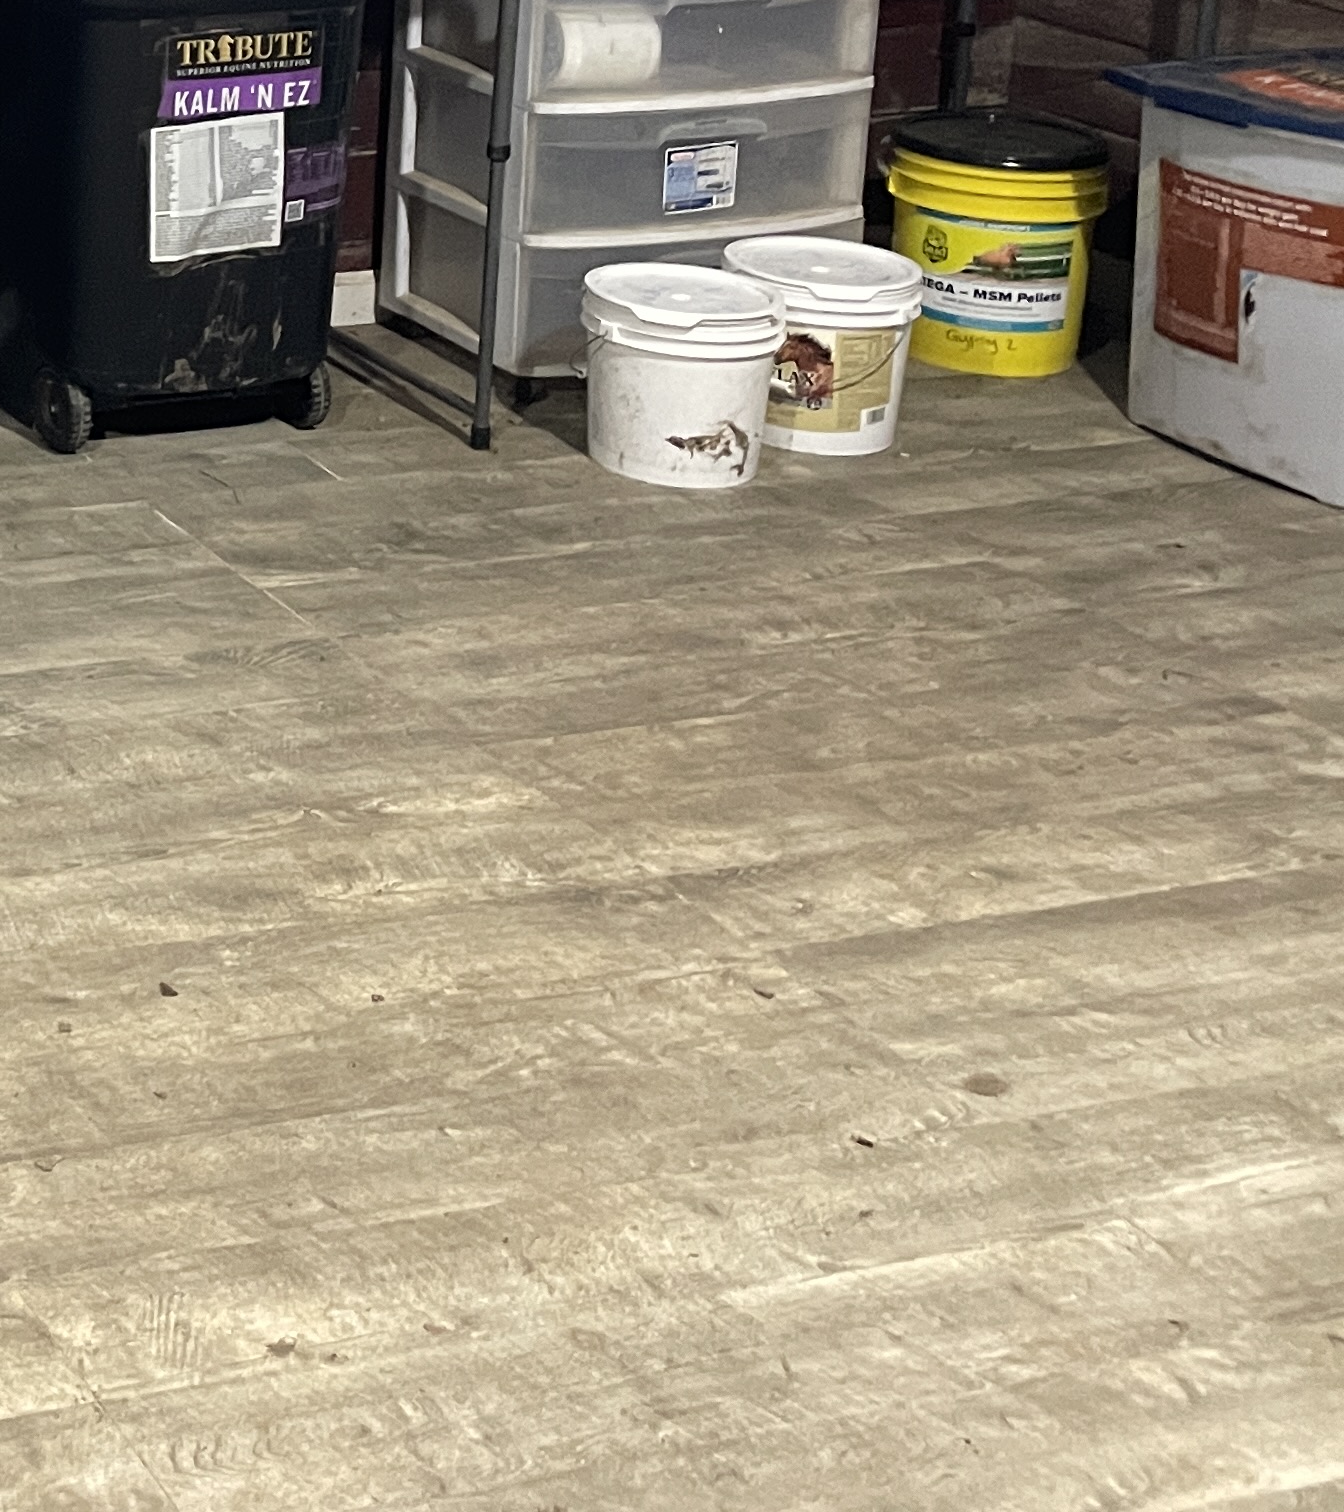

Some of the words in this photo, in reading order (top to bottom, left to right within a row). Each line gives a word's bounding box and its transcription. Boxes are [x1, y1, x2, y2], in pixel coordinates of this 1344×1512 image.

[177, 29, 313, 67] TRIBUTE
[176, 66, 221, 77] SUPERIOR
[223, 62, 257, 73] EQUINE
[260, 58, 311, 69] NUTRITION
[174, 85, 240, 117] KALM
[283, 80, 311, 106] EZ
[973, 289, 1012, 302] MSM
[1017, 292, 1062, 303] Pellets
